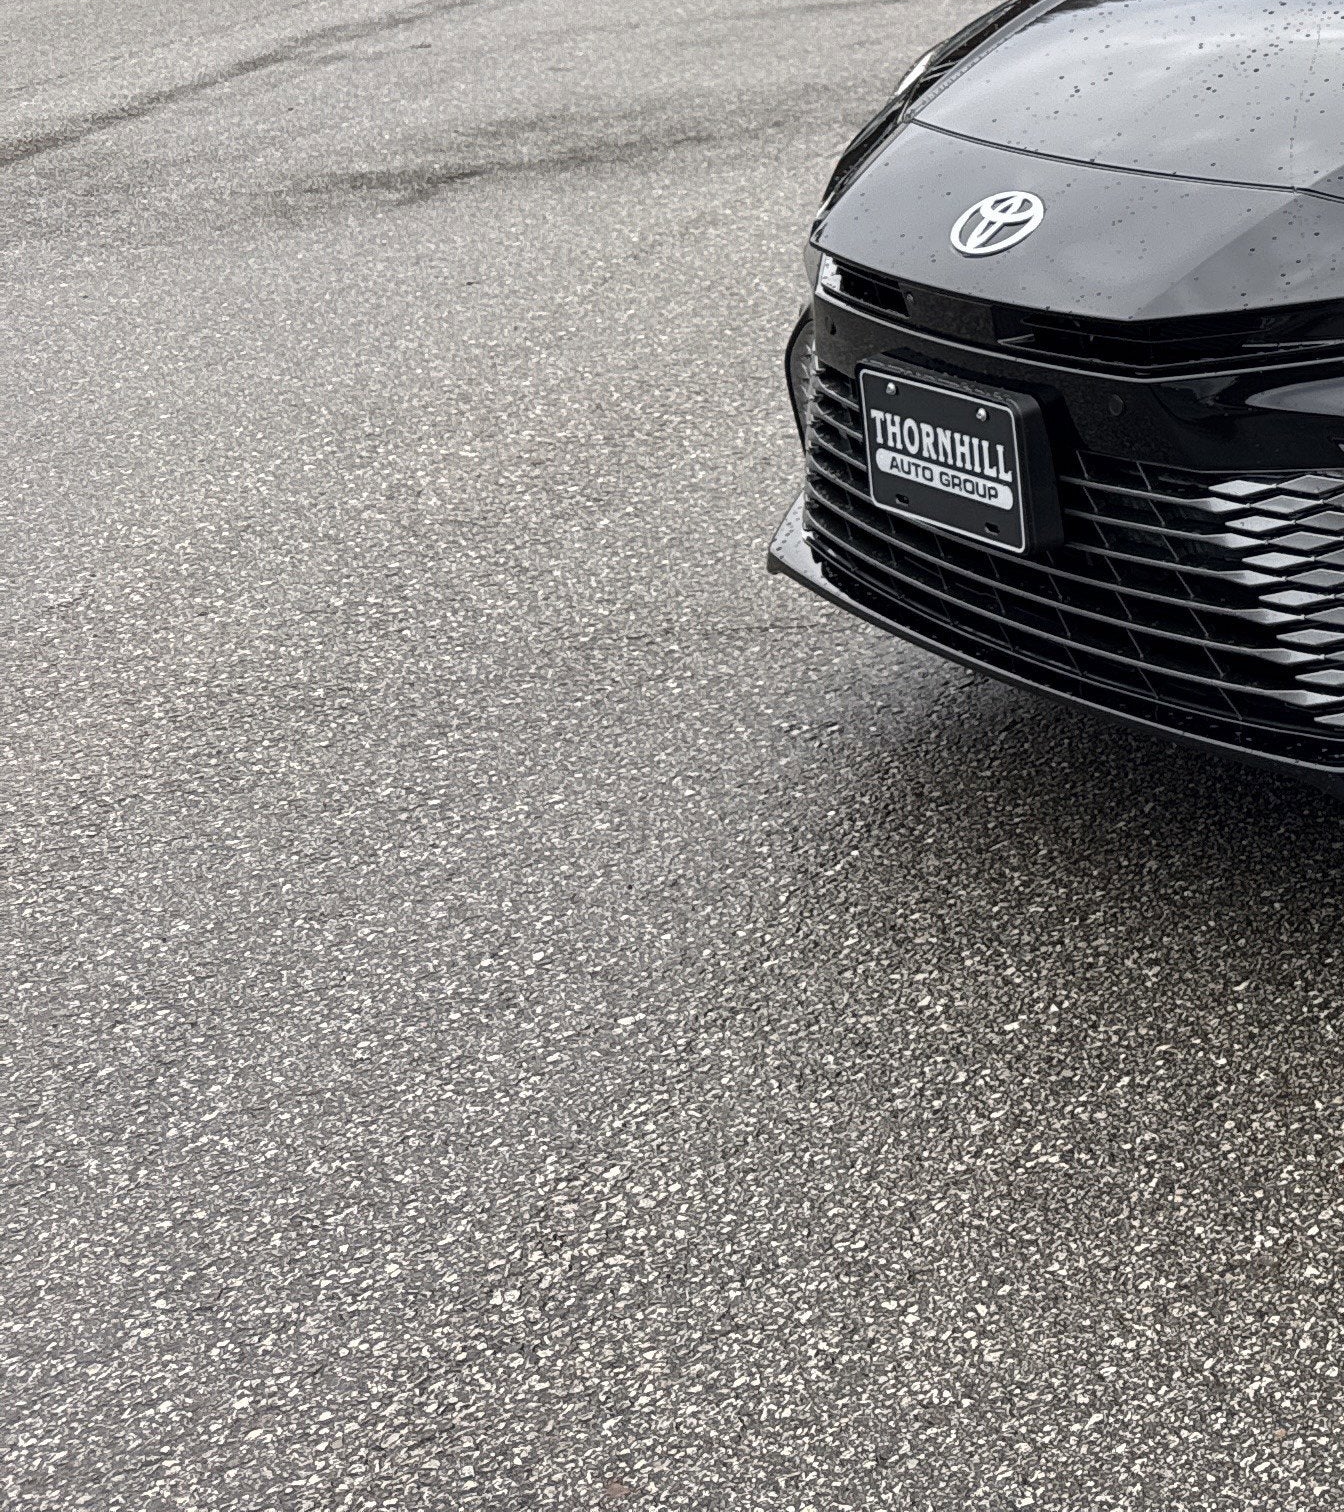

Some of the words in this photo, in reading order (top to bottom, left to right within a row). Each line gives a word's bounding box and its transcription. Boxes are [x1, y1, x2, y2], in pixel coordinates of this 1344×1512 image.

[870, 409, 1013, 482] THORNHILL
[889, 456, 934, 483] AUTO
[939, 471, 999, 501] GROUP
